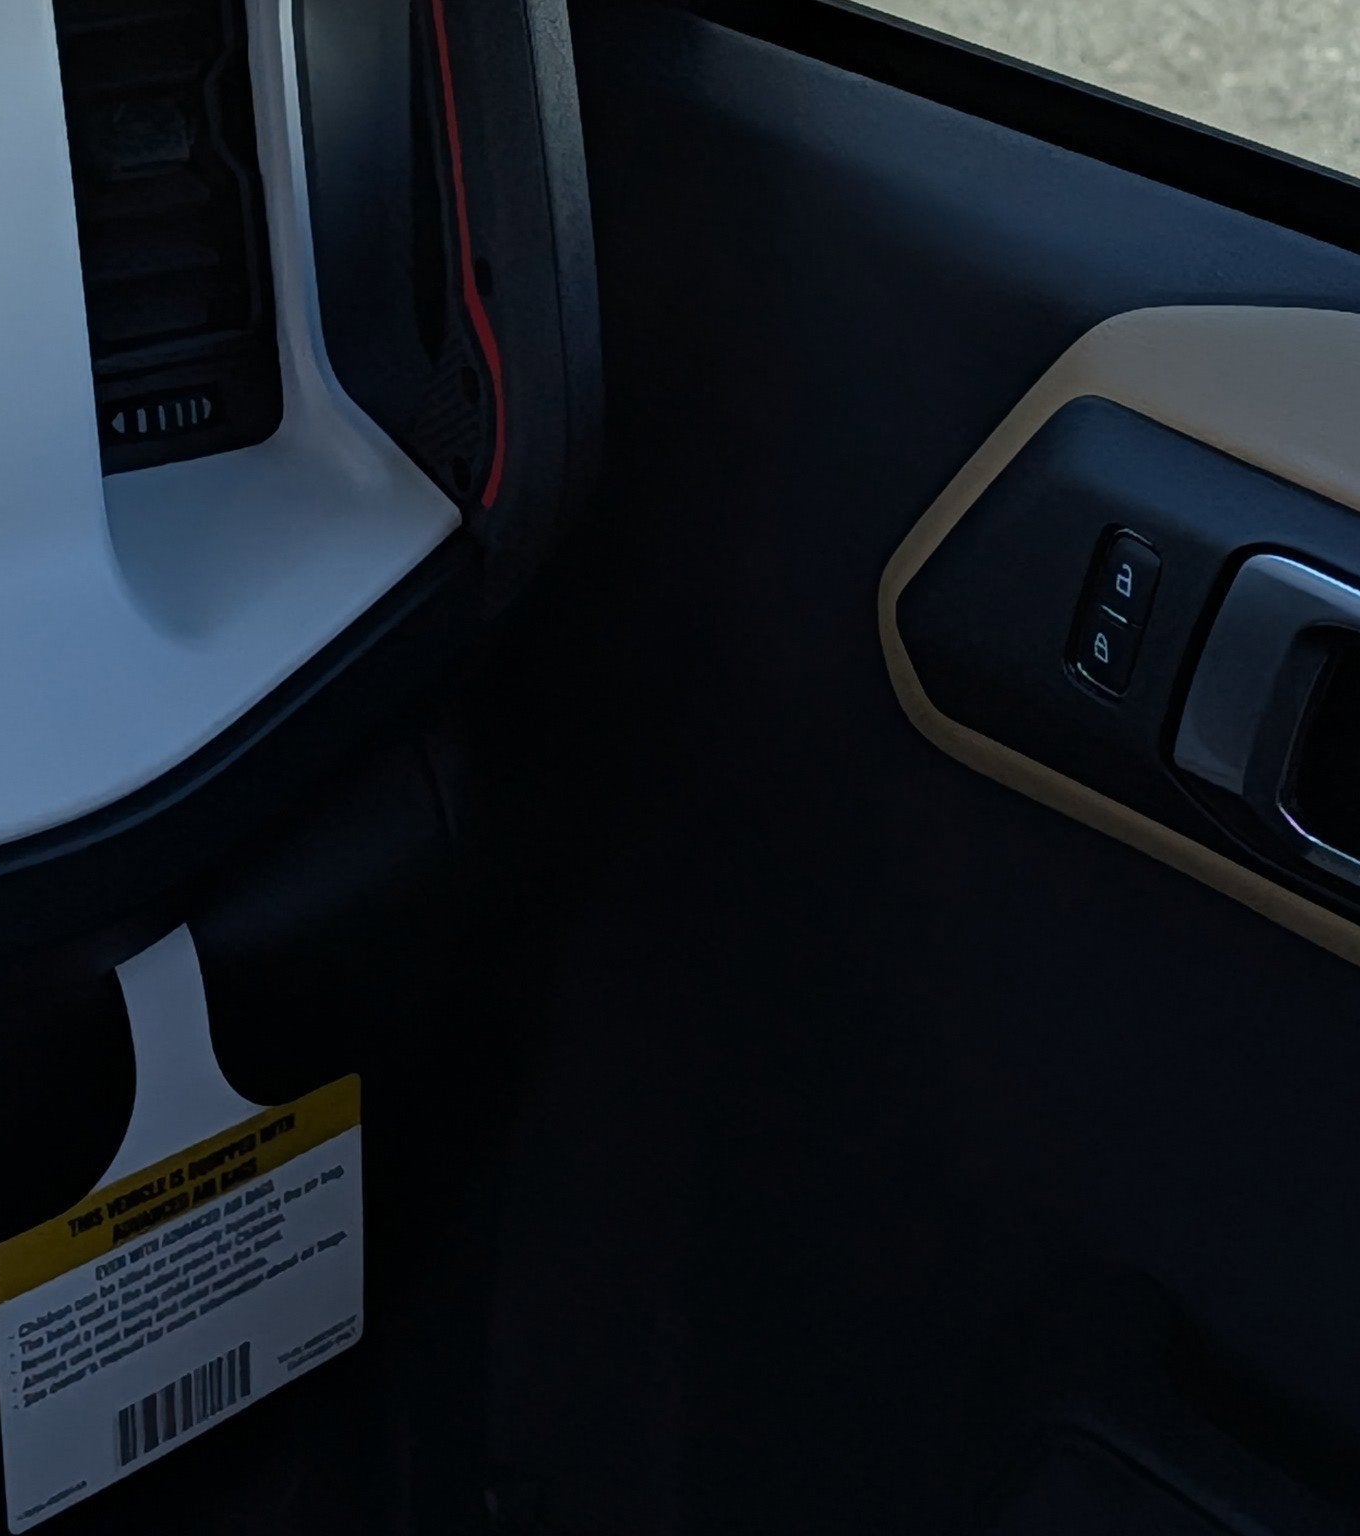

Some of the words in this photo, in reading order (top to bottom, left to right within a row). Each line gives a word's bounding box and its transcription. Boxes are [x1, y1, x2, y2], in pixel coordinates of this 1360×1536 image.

[68, 1207, 104, 1237] THIS
[106, 1177, 167, 1218] VEHICLE
[169, 1167, 185, 1189] IS
